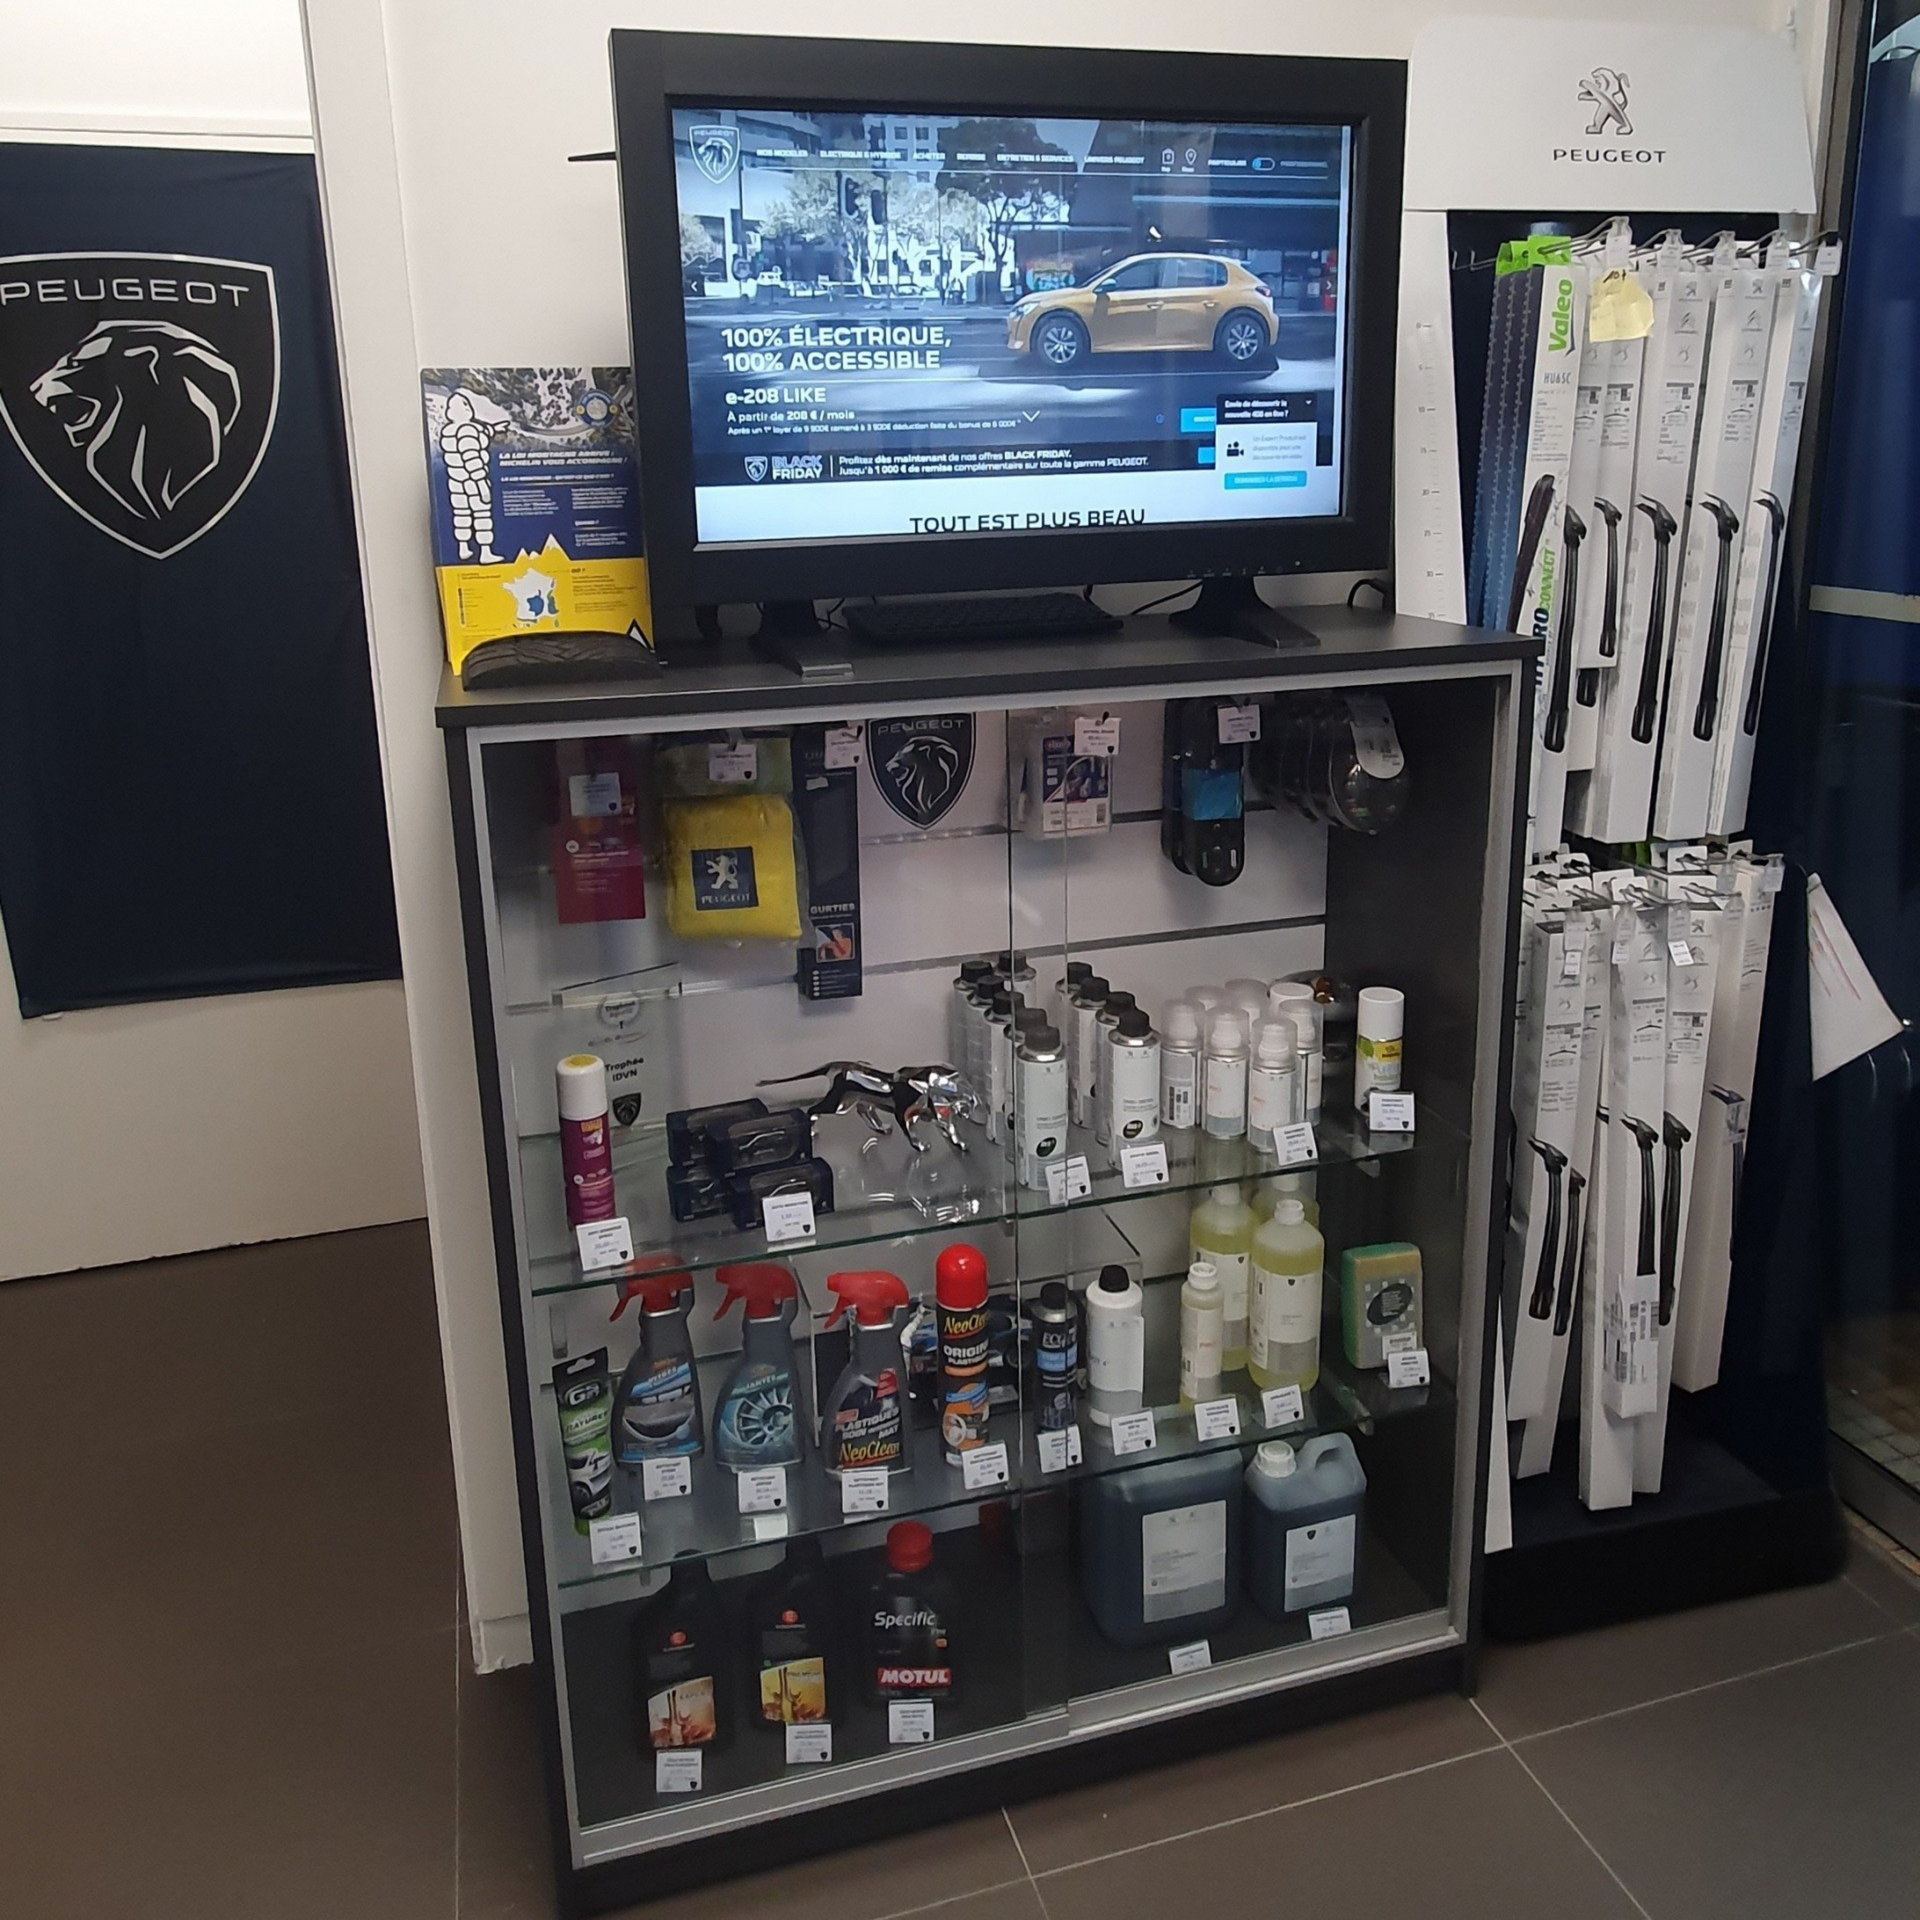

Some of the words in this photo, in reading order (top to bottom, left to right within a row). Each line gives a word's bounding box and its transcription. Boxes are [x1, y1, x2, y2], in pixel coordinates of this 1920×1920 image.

[1553, 148, 1667, 164] PEUGEOT
[0, 279, 249, 306] PEUGEOT
[1548, 279, 1572, 352] Valeo
[721, 328, 782, 348] 100%
[789, 323, 952, 349] ÉLECTRIQUE,
[722, 352, 783, 373] 100%
[789, 350, 940, 372] ACCESSIBLE
[725, 389, 779, 405] e-208
[784, 387, 826, 403] LIKE
[727, 411, 736, 422] À
[739, 411, 768, 424] partir
[770, 411, 784, 421] de
[820, 410, 824, 421] /
[827, 410, 855, 420] mois
[728, 426, 750, 436] Après
[771, 455, 823, 469] BLACK
[839, 455, 873, 466] Profitez
[875, 454, 892, 464] dès
[894, 453, 947, 463] maintenant
[948, 452, 959, 461] de
[961, 453, 977, 461] nos
[978, 451, 1003, 461] offres
[1005, 450, 1035, 460] BLACK
[1037, 449, 1072, 459] FRIDAY.
[772, 467, 823, 481] FRIDAY
[839, 466, 873, 477] Jusqu'à
[908, 463, 920, 473] de
[922, 463, 952, 473] remise
[954, 461, 1023, 472] complémentaire
[1025, 462, 1038, 470] sur
[1040, 461, 1062, 469] toute
[1064, 460, 1071, 468] la
[1073, 459, 1106, 470] gamme
[1107, 457, 1149, 467] PEUGEOT.
[909, 515, 971, 533] TOUT
[978, 513, 1019, 531] EST
[1026, 511, 1081, 529] PLUS
[1087, 508, 1145, 526] BEAU
[877, 718, 965, 736] PEUGEOT
[701, 893, 750, 905] PEUGEOT
[604, 1057, 645, 1072] Trophée
[835, 1407, 899, 1432] PLASTIQUES
[839, 1441, 900, 1462] NeoClean
[874, 1611, 936, 1630] Specific
[880, 1669, 949, 1684] MOTUL
